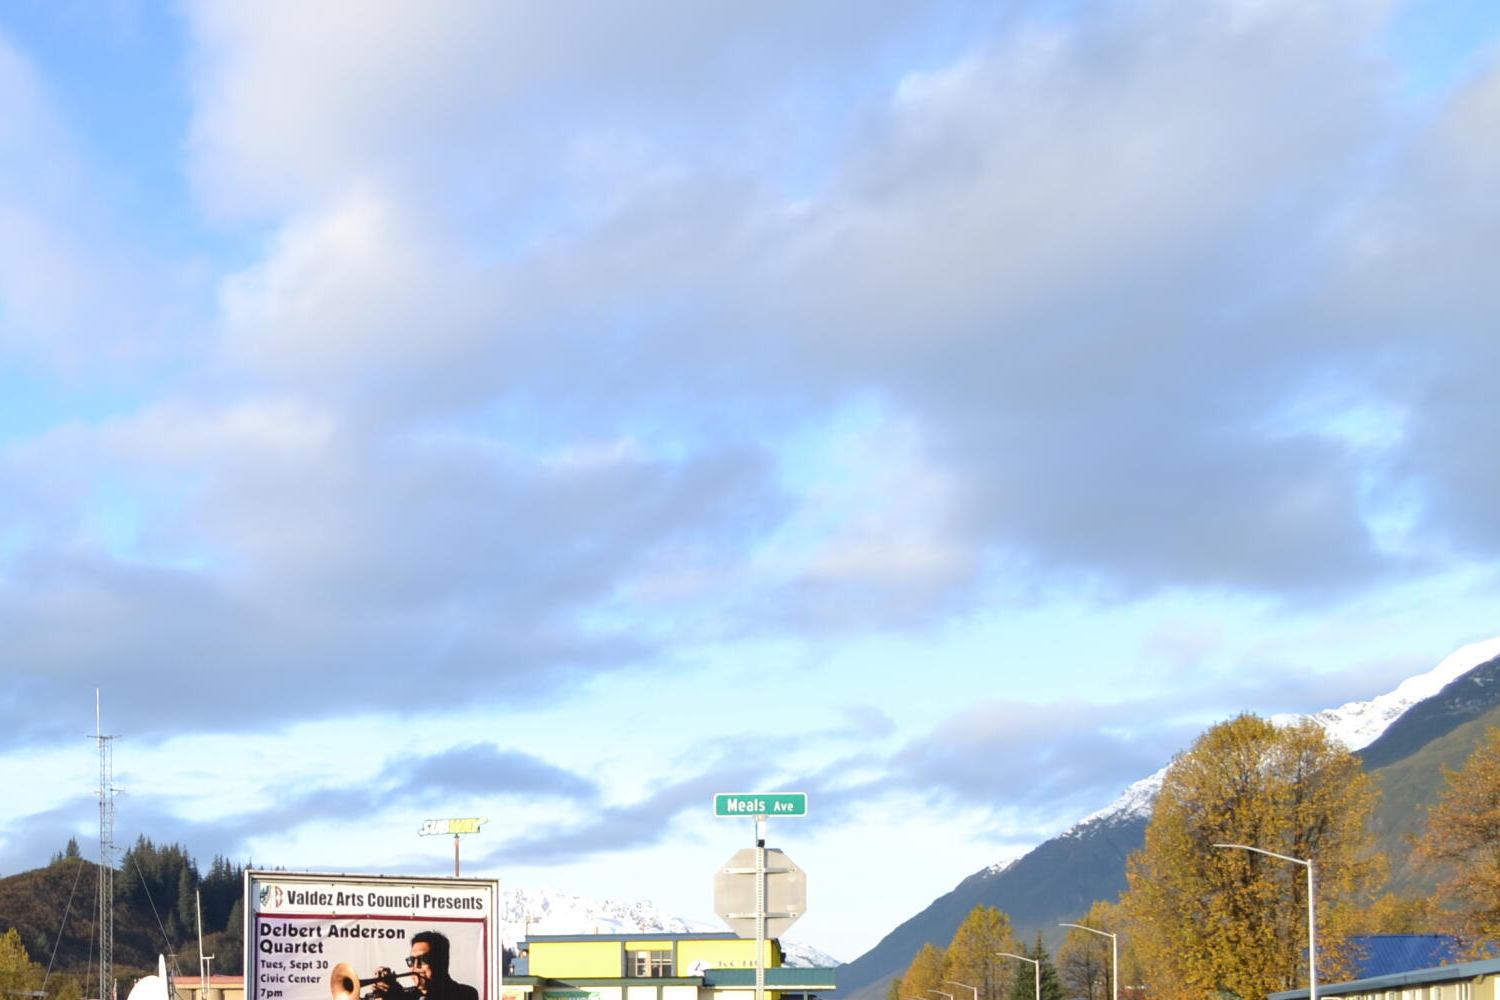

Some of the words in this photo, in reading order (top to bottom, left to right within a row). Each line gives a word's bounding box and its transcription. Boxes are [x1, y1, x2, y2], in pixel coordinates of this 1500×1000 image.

[727, 798, 766, 813] Meals
[773, 800, 794, 812] Ave
[287, 890, 333, 906] Valdez
[336, 892, 364, 907] Arts
[367, 892, 420, 909] Council
[423, 894, 483, 910] Presents
[260, 923, 322, 938] Delbert
[327, 924, 406, 939] Anderson
[260, 939, 323, 954] Quartet
[260, 960, 286, 971] Tues,
[290, 960, 313, 971] Sept
[316, 960, 329, 969] 30
[260, 973, 285, 983] Civic
[288, 974, 321, 984] Center
[260, 988, 283, 999] 7pm
